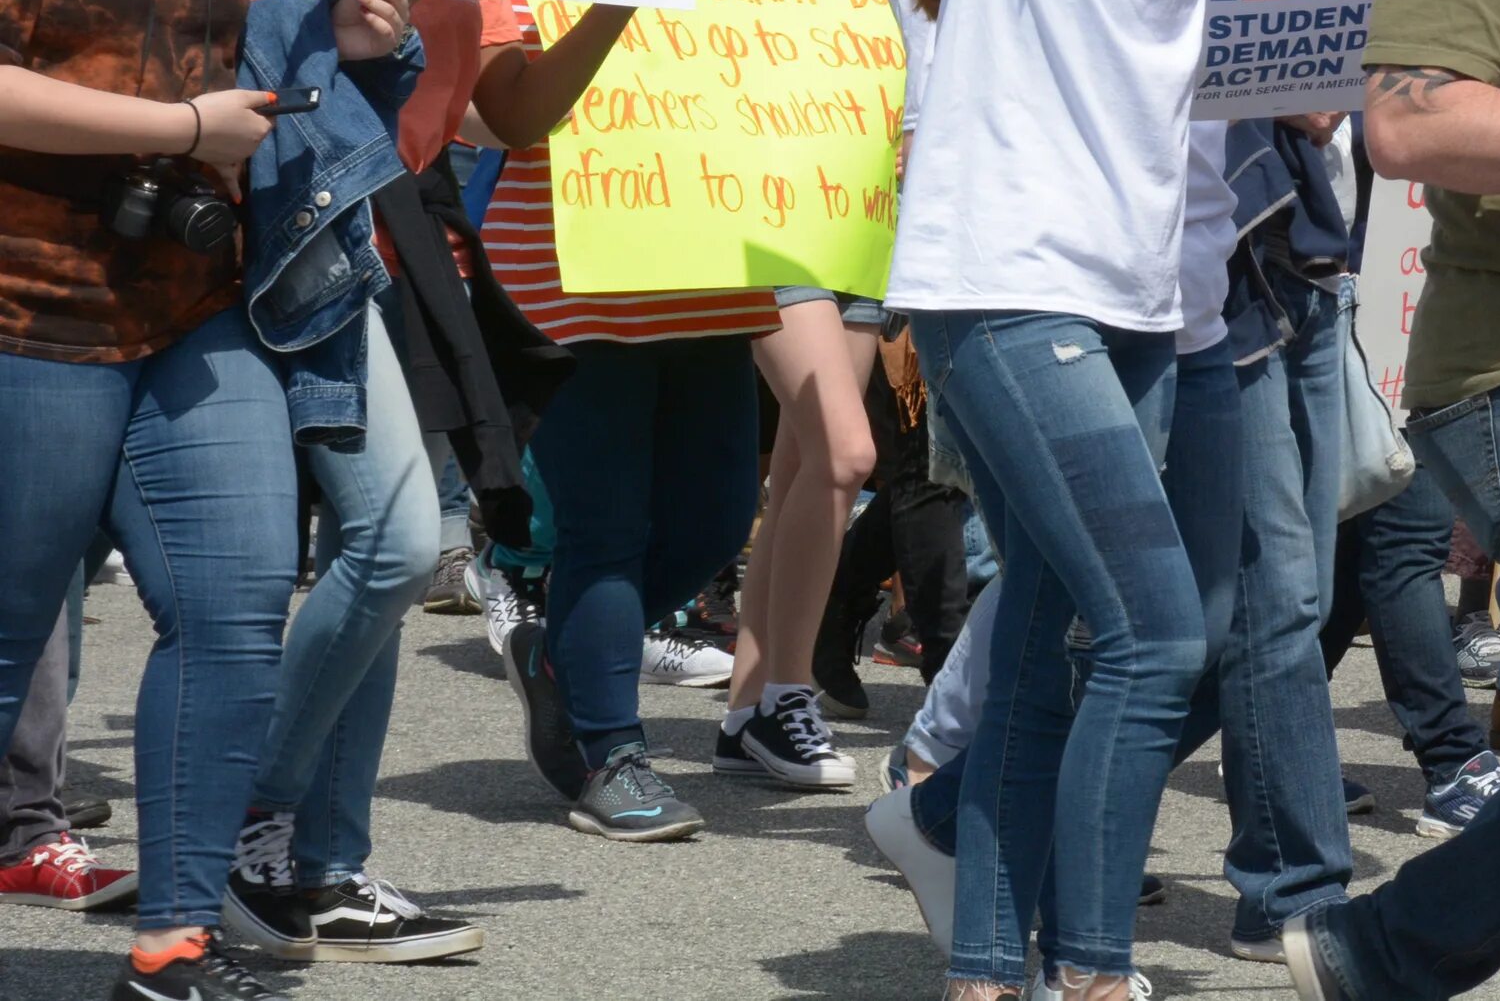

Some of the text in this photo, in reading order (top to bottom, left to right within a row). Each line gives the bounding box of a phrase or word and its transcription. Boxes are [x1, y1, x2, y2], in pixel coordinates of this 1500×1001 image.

[655, 7, 698, 62] to
[708, 22, 749, 88] go
[754, 19, 798, 66] to
[1205, 29, 1368, 68] DEMAND
[1195, 90, 1221, 101] FOR
[1225, 88, 1252, 100] GUN
[1255, 82, 1297, 96] SENSE
[1299, 81, 1313, 92] IN
[1198, 56, 1345, 89] ACTION
[736, 88, 867, 138] shouldn't
[561, 148, 672, 211] afraid
[699, 152, 744, 214] to
[762, 174, 796, 229] go
[816, 165, 850, 220] to
